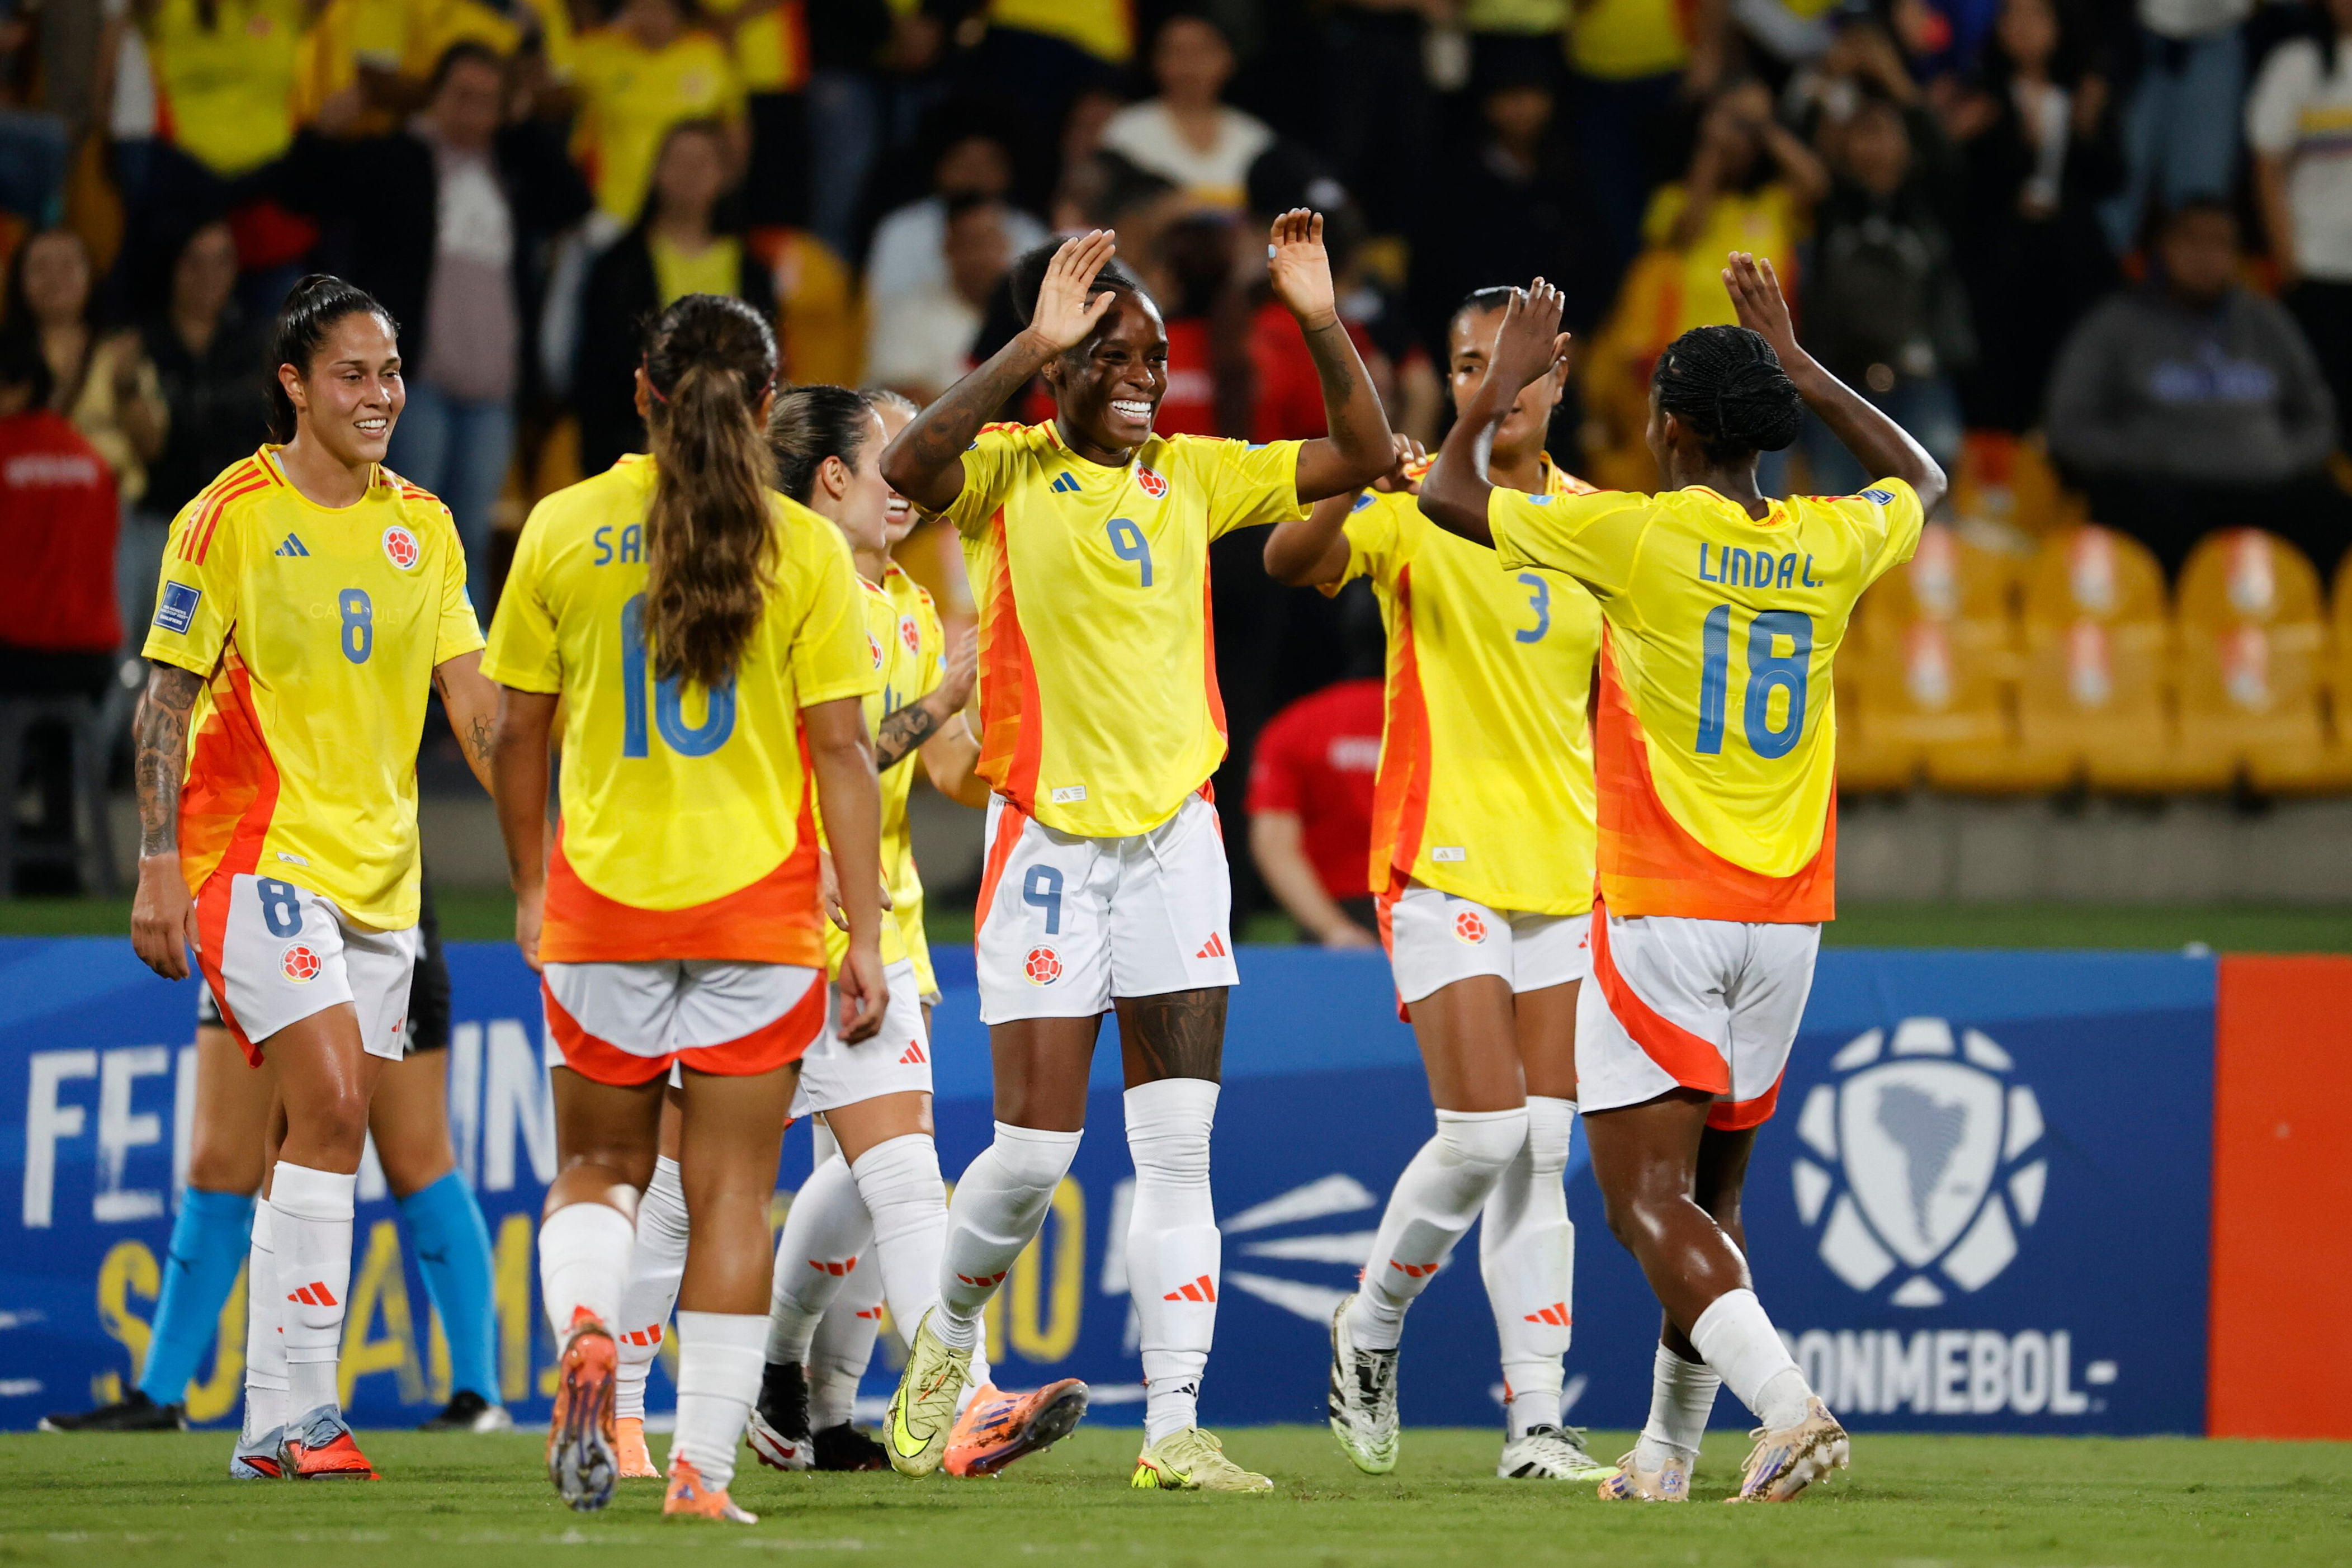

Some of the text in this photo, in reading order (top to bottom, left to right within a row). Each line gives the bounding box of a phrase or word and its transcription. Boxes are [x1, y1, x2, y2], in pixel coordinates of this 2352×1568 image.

[593, 523, 650, 566] SA
[1106, 518, 1153, 587] 9
[1699, 542, 1797, 589] LINDA
[309, 602, 404, 624] CAULT
[338, 588, 373, 664] 8
[1515, 573, 1550, 644] 3
[1695, 603, 1813, 759] 18
[257, 877, 303, 938] 8
[1023, 863, 1064, 935] 9
